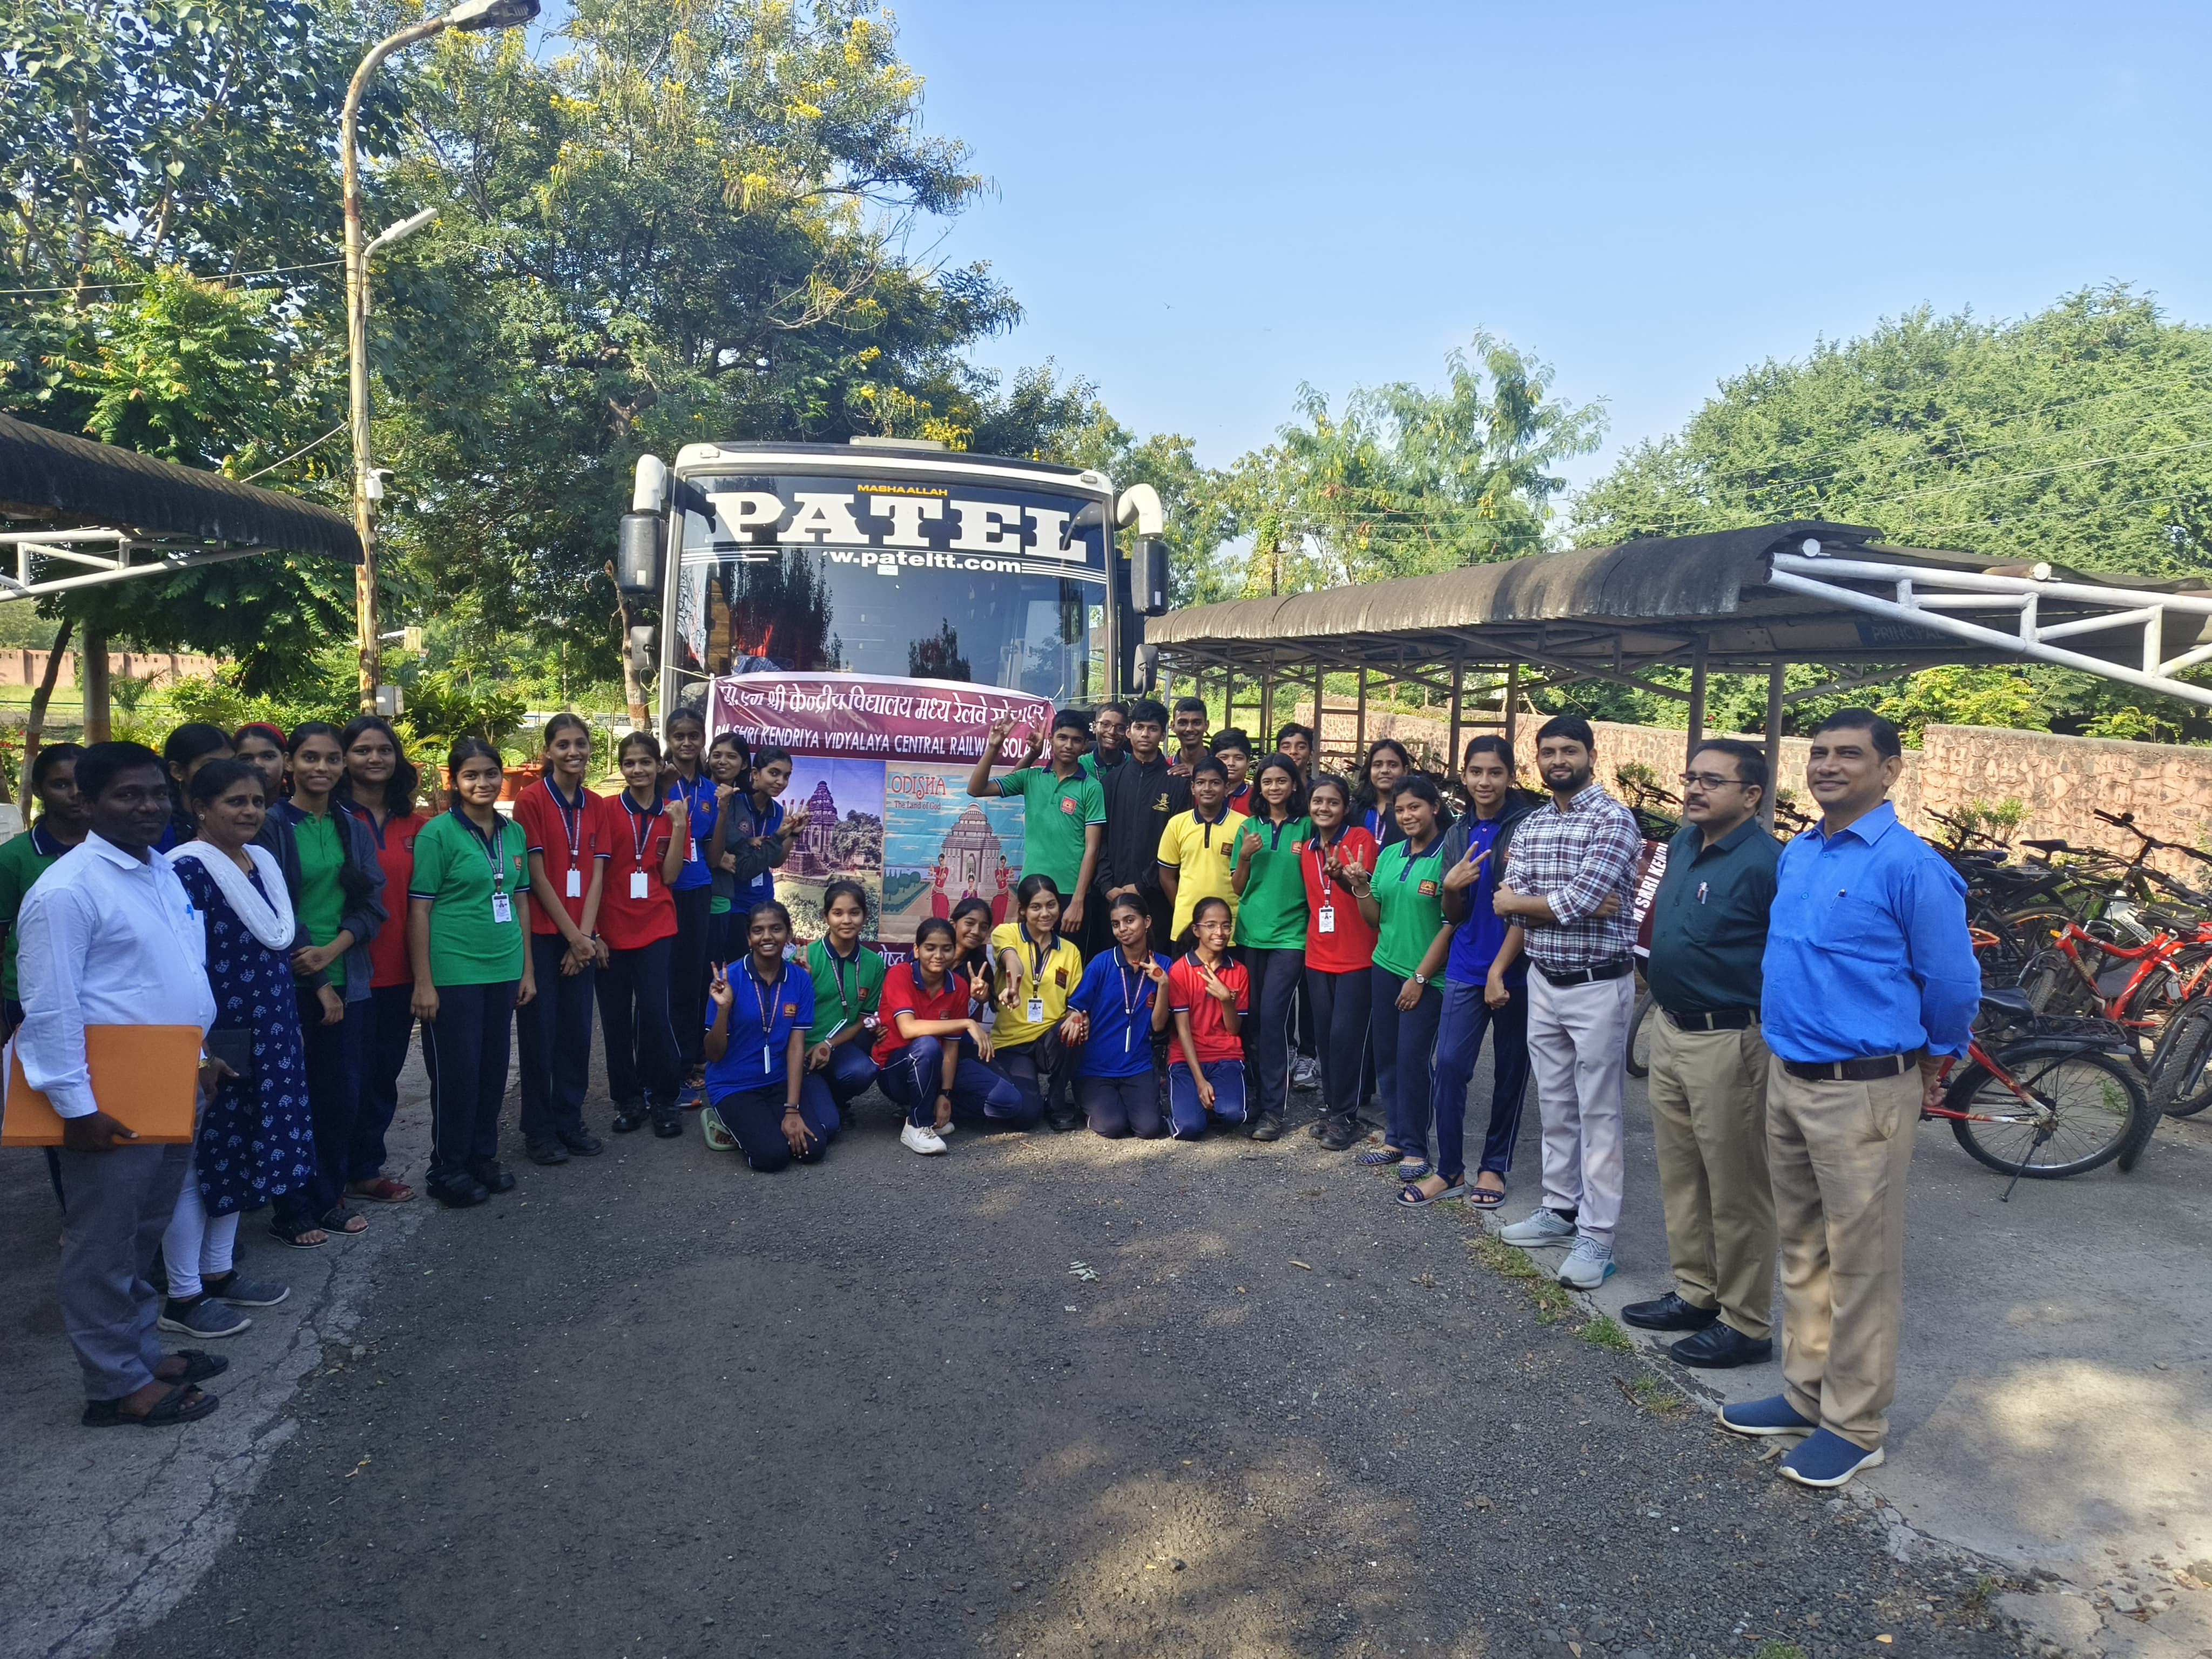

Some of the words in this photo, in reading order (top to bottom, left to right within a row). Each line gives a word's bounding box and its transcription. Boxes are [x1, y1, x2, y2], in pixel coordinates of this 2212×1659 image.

[705, 492, 1087, 563] PATEL
[818, 551, 1021, 574] w.pateltt.com
[789, 683, 846, 714] केन्द्रीय
[848, 685, 913, 718] विद्यालय
[915, 697, 952, 722] मध्य
[953, 692, 988, 724] रेलवे
[733, 725, 759, 745] SHRI
[760, 726, 819, 748] KENDRIYA
[825, 731, 889, 752] VIDYALAYA
[894, 734, 945, 755] CENTRAL
[949, 736, 989, 756] RAILW
[1002, 738, 1052, 760] SOLAUR
[891, 775, 946, 800] ODISHA
[894, 800, 906, 808] The
[907, 801, 921, 809] Land
[929, 802, 941, 810] God
[1647, 842, 1669, 877] KEND
[1635, 875, 1660, 908] SHRI
